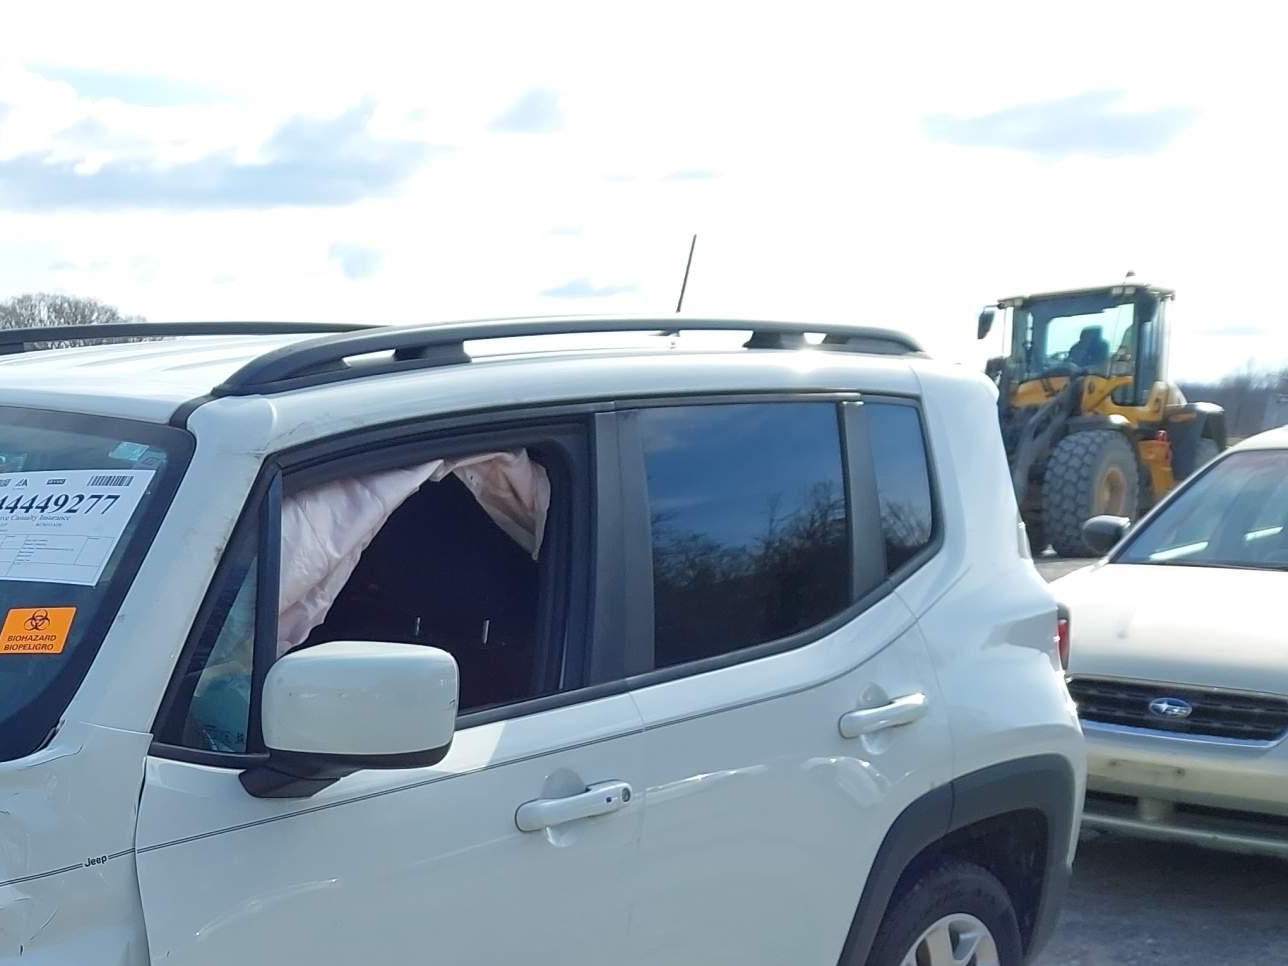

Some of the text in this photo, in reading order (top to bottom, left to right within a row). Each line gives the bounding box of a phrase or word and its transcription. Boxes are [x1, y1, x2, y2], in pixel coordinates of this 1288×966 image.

[7, 634, 57, 642] BIOHAZARD
[3, 643, 54, 651] BIOPELIGRO
[84, 855, 108, 867] Jeep
